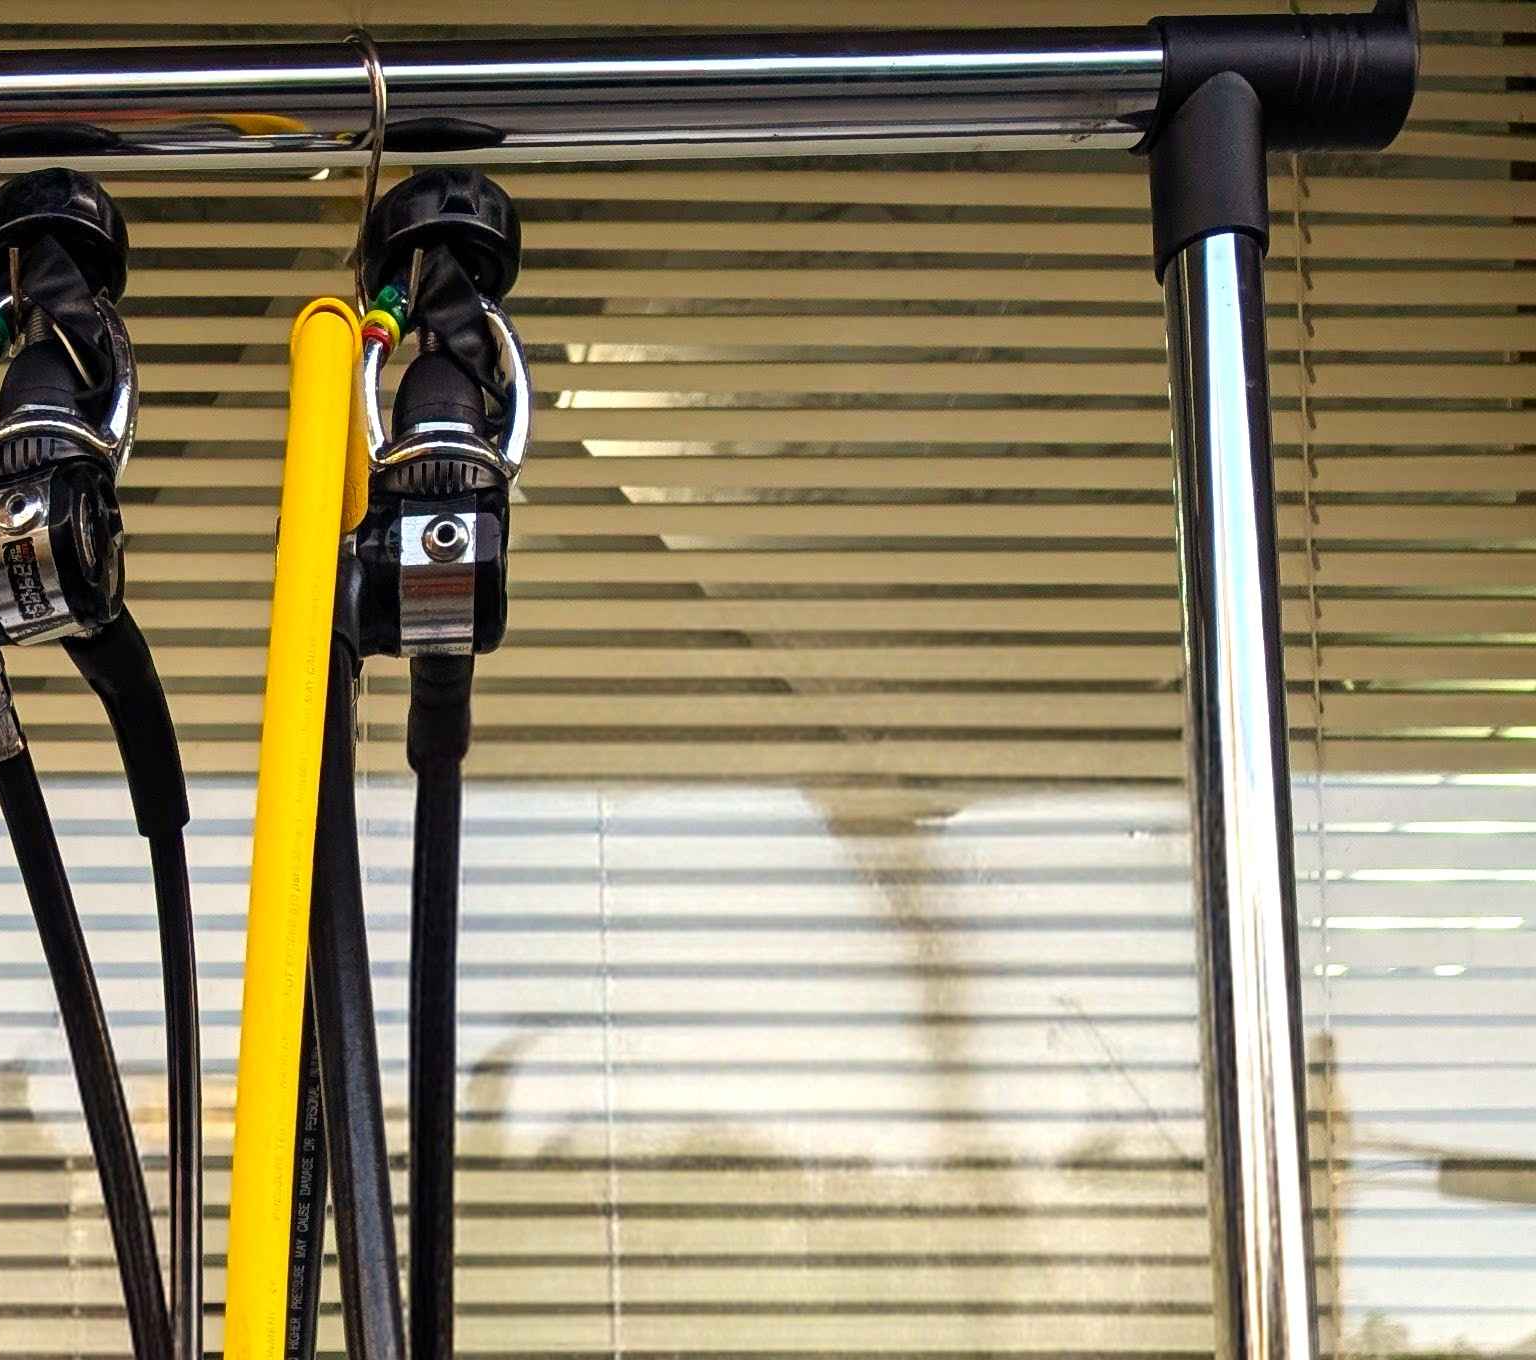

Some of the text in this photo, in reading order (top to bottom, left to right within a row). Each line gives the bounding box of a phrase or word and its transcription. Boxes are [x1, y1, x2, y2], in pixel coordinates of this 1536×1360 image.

[305, 1137, 315, 1151] OR
[299, 1157, 314, 1196] DAMAGE
[297, 1202, 310, 1233] CAUSE
[295, 1240, 307, 1258] MAY
[291, 1264, 304, 1310] PRESSURE
[289, 1317, 301, 1350] HIGHER
